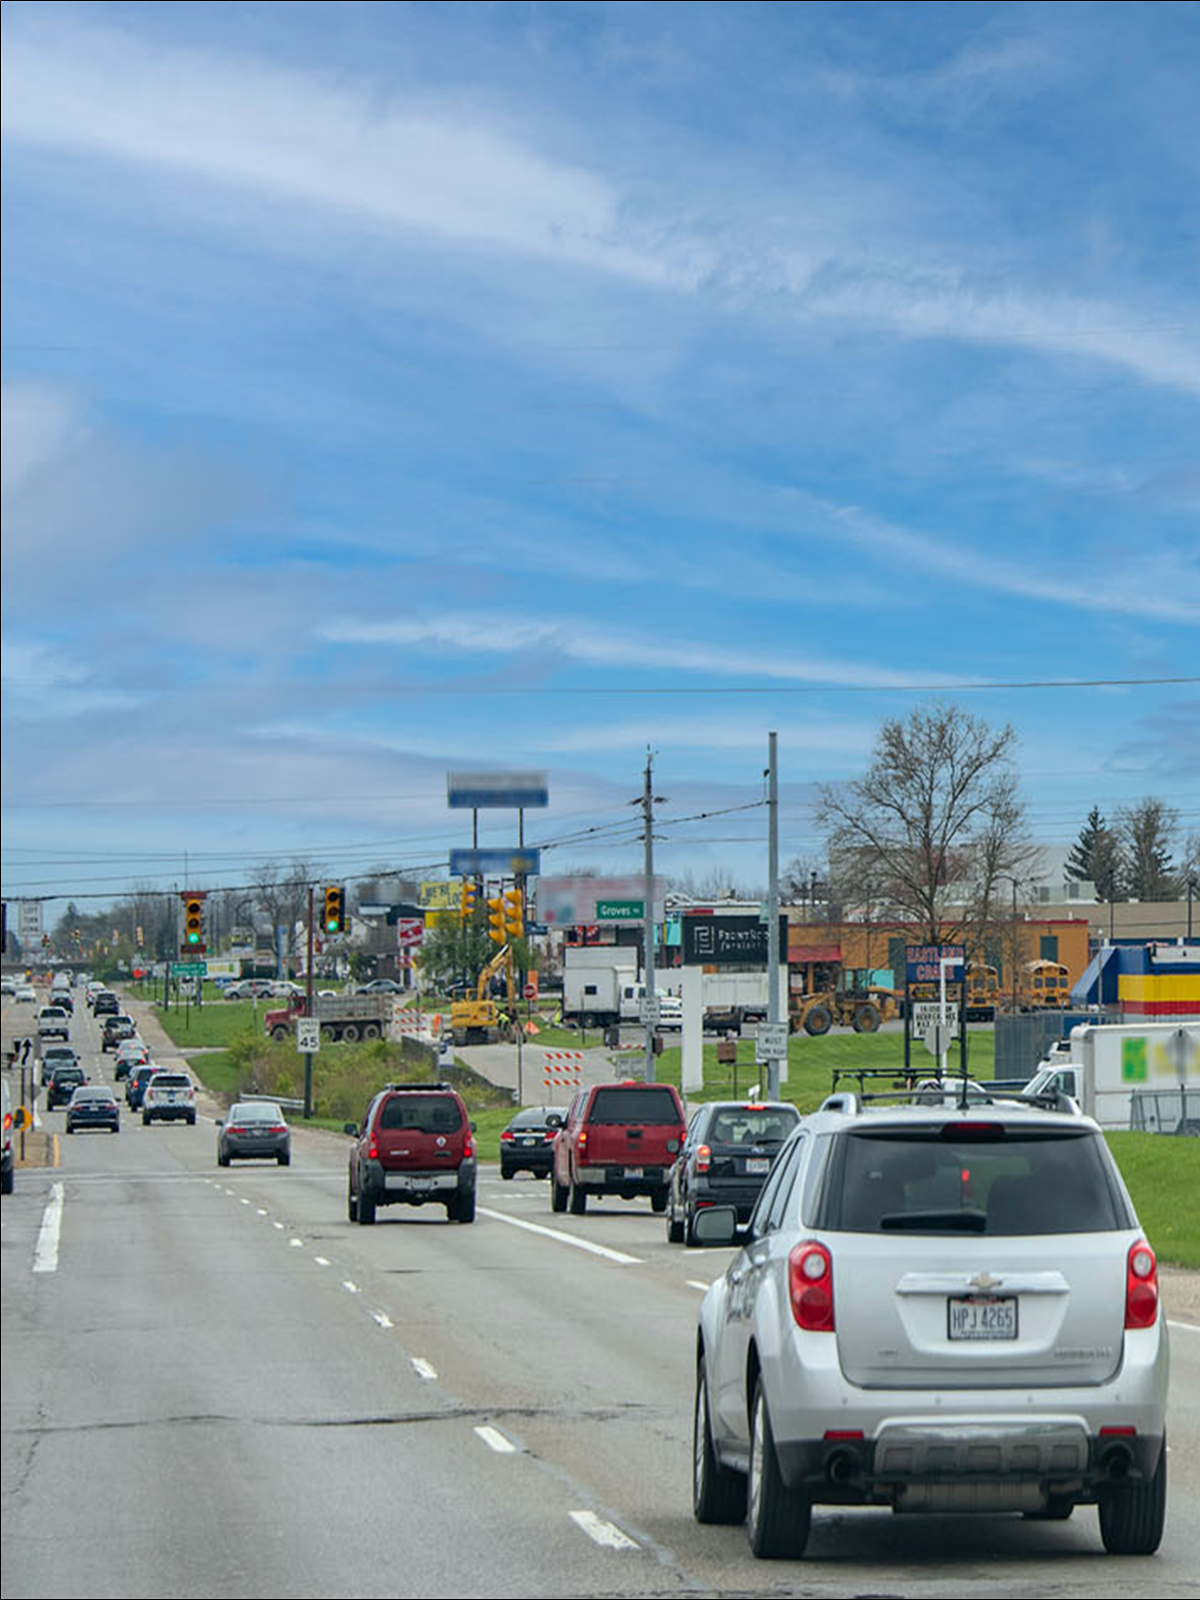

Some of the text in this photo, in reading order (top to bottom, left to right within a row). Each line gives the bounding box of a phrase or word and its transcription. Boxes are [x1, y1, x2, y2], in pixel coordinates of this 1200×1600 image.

[600, 904, 631, 917] Groves
[907, 947, 964, 962] EASTLAND
[299, 1036, 318, 1048] 45
[952, 1307, 1013, 1330] HPJ 4265
